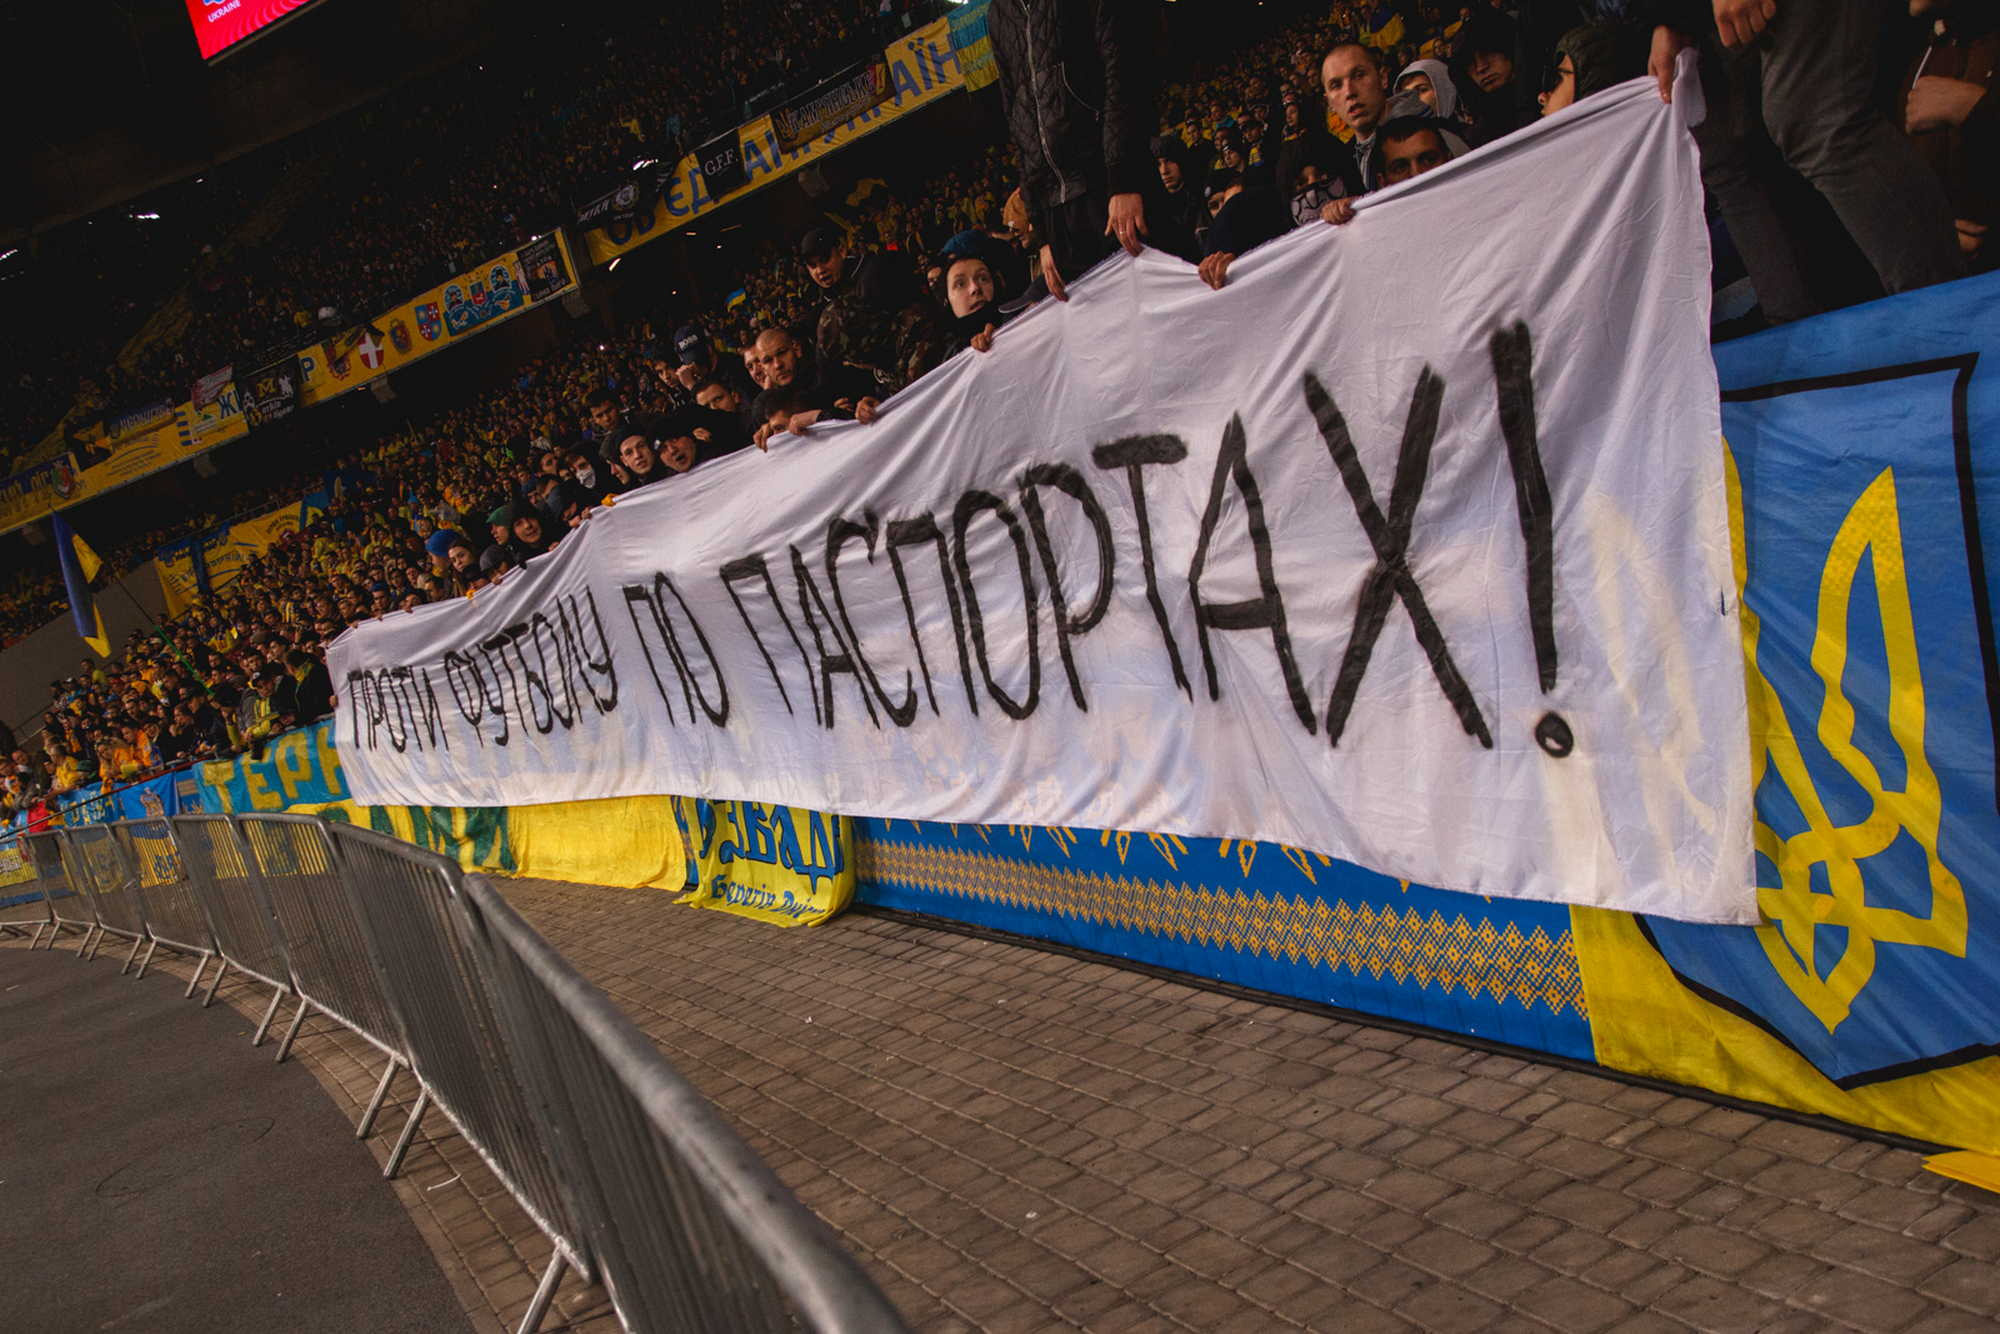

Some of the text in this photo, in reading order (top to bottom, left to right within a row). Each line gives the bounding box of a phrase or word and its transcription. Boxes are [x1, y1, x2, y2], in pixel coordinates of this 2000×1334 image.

[347, 320, 1575, 758] ПРОТИ ФУТБОЛУ ПО ПАСПОРТАХ!
